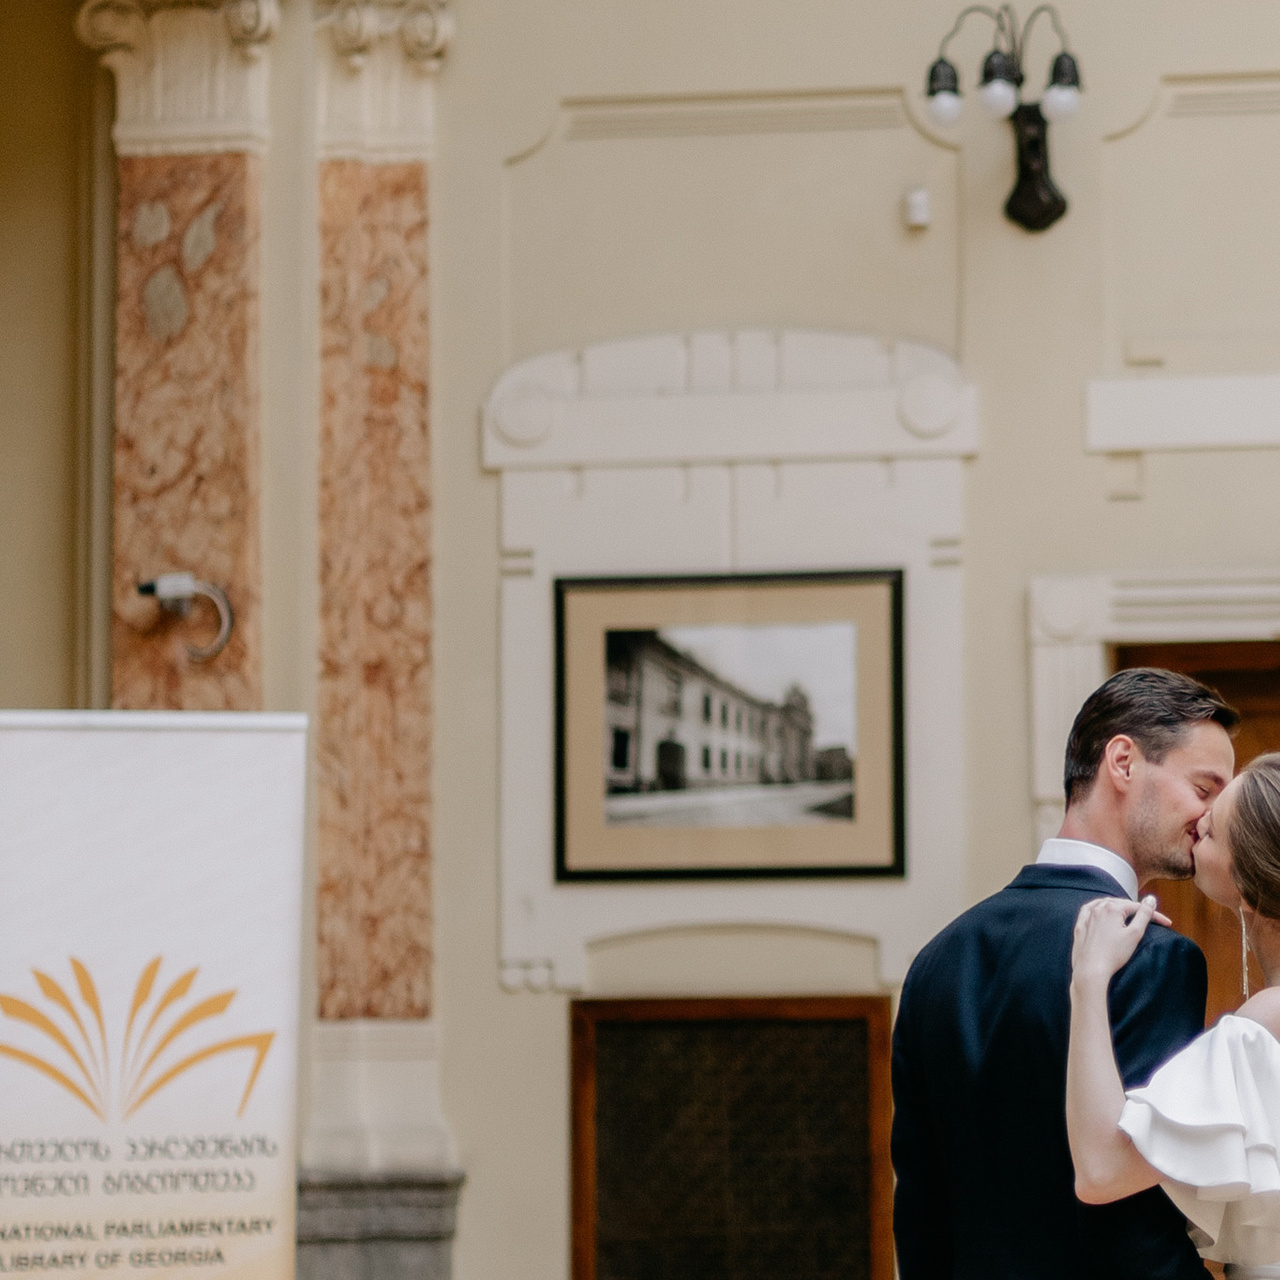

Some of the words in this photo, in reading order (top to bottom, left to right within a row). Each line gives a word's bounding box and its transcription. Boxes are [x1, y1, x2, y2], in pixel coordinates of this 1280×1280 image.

[103, 1216, 275, 1239] PARLIAMENTARY
[94, 1248, 121, 1269] OF
[129, 1245, 225, 1269] GEORGIA
